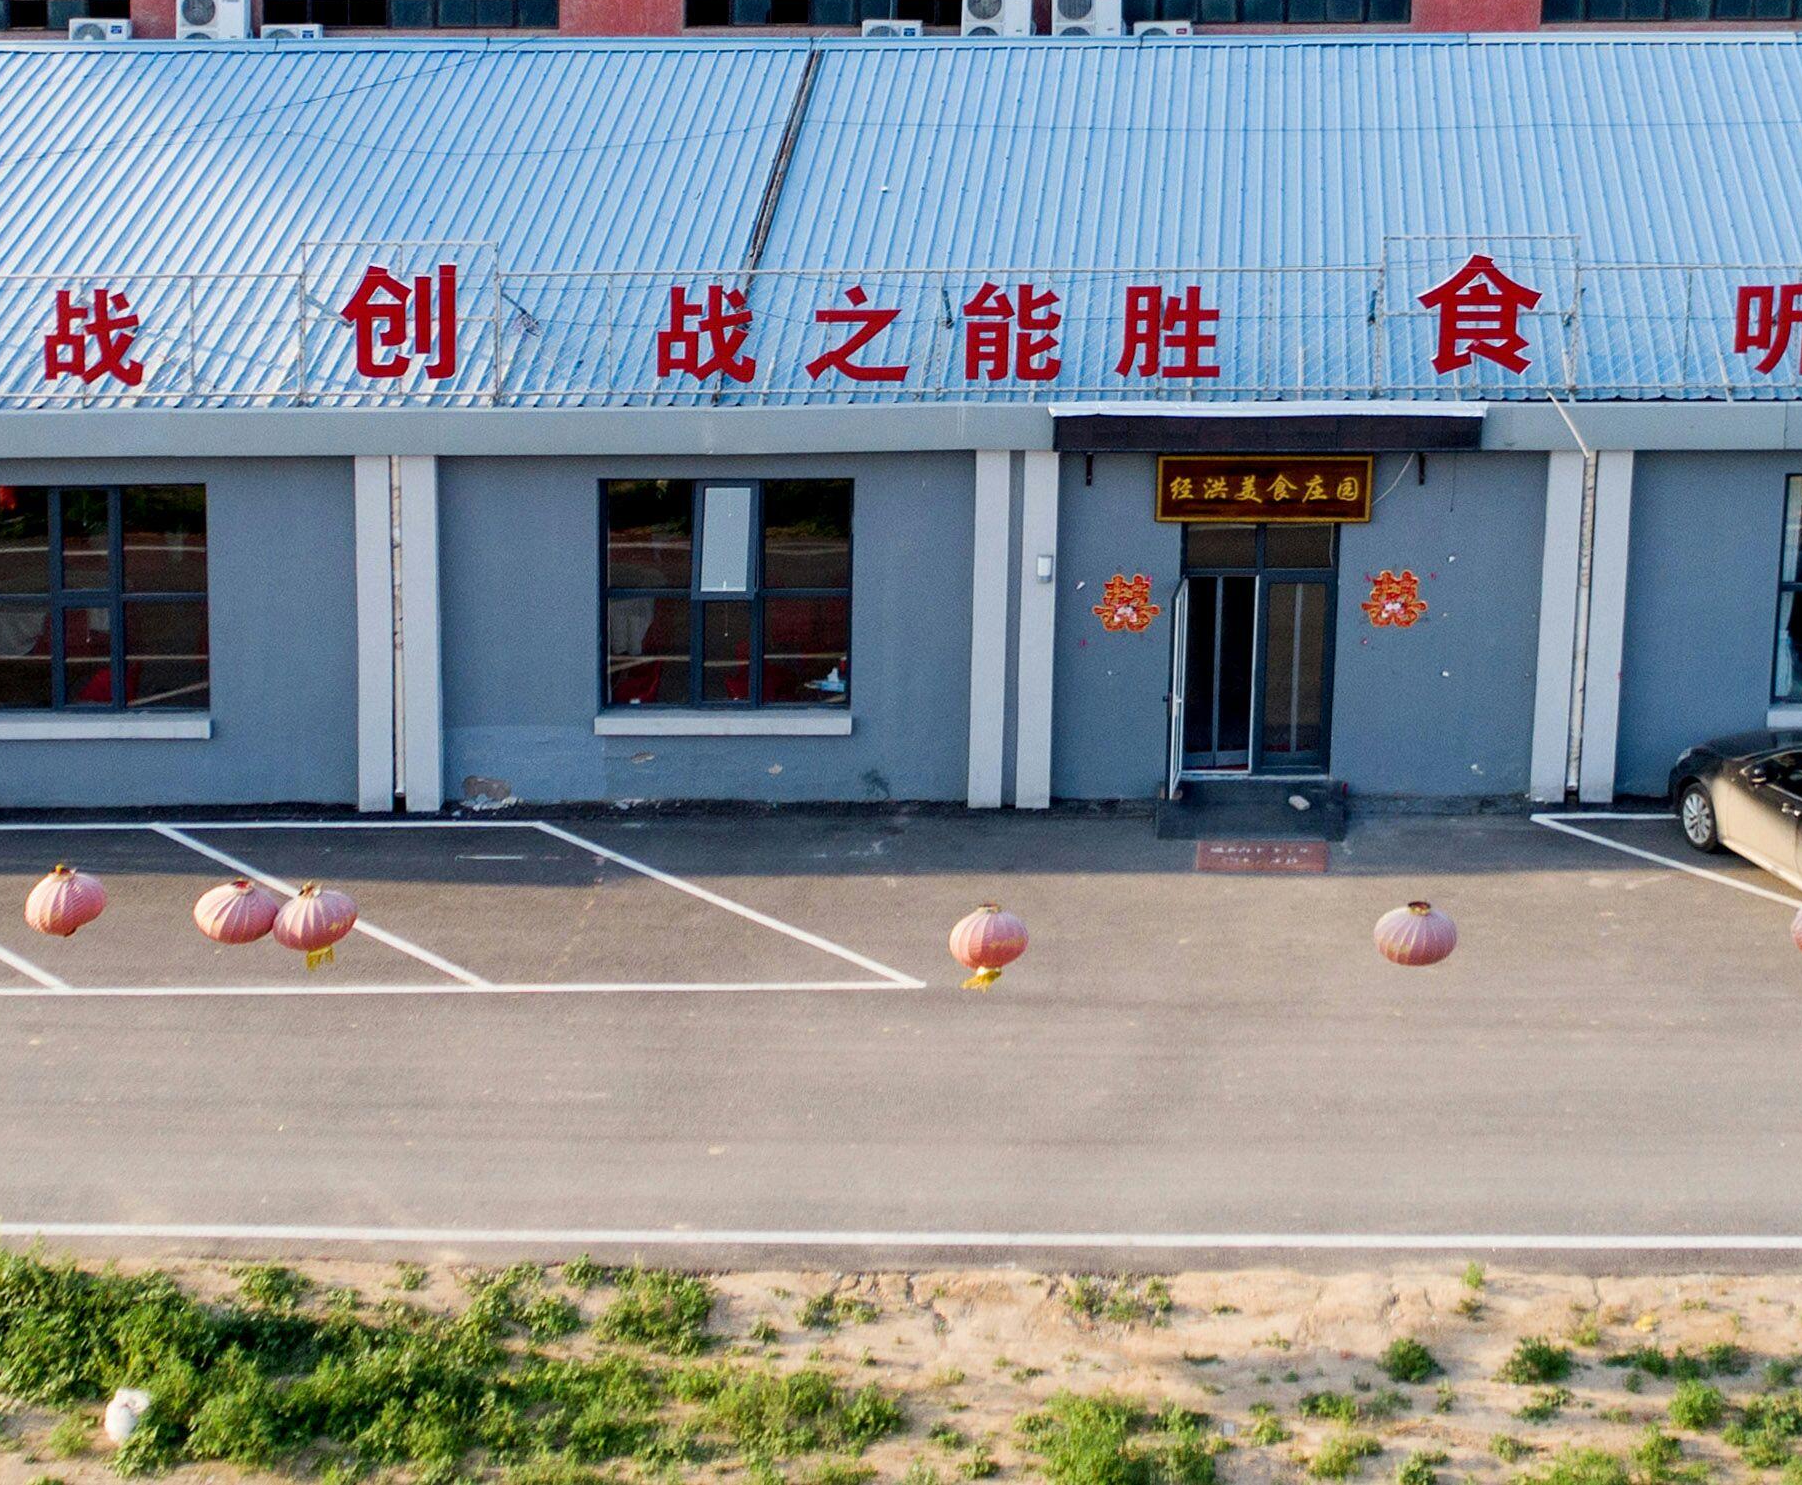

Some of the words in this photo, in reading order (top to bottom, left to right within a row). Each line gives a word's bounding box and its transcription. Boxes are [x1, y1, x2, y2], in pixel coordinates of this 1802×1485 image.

[342, 264, 458, 380] 创
[657, 283, 1221, 383] 战之能胜
[1418, 254, 1542, 374] 食
